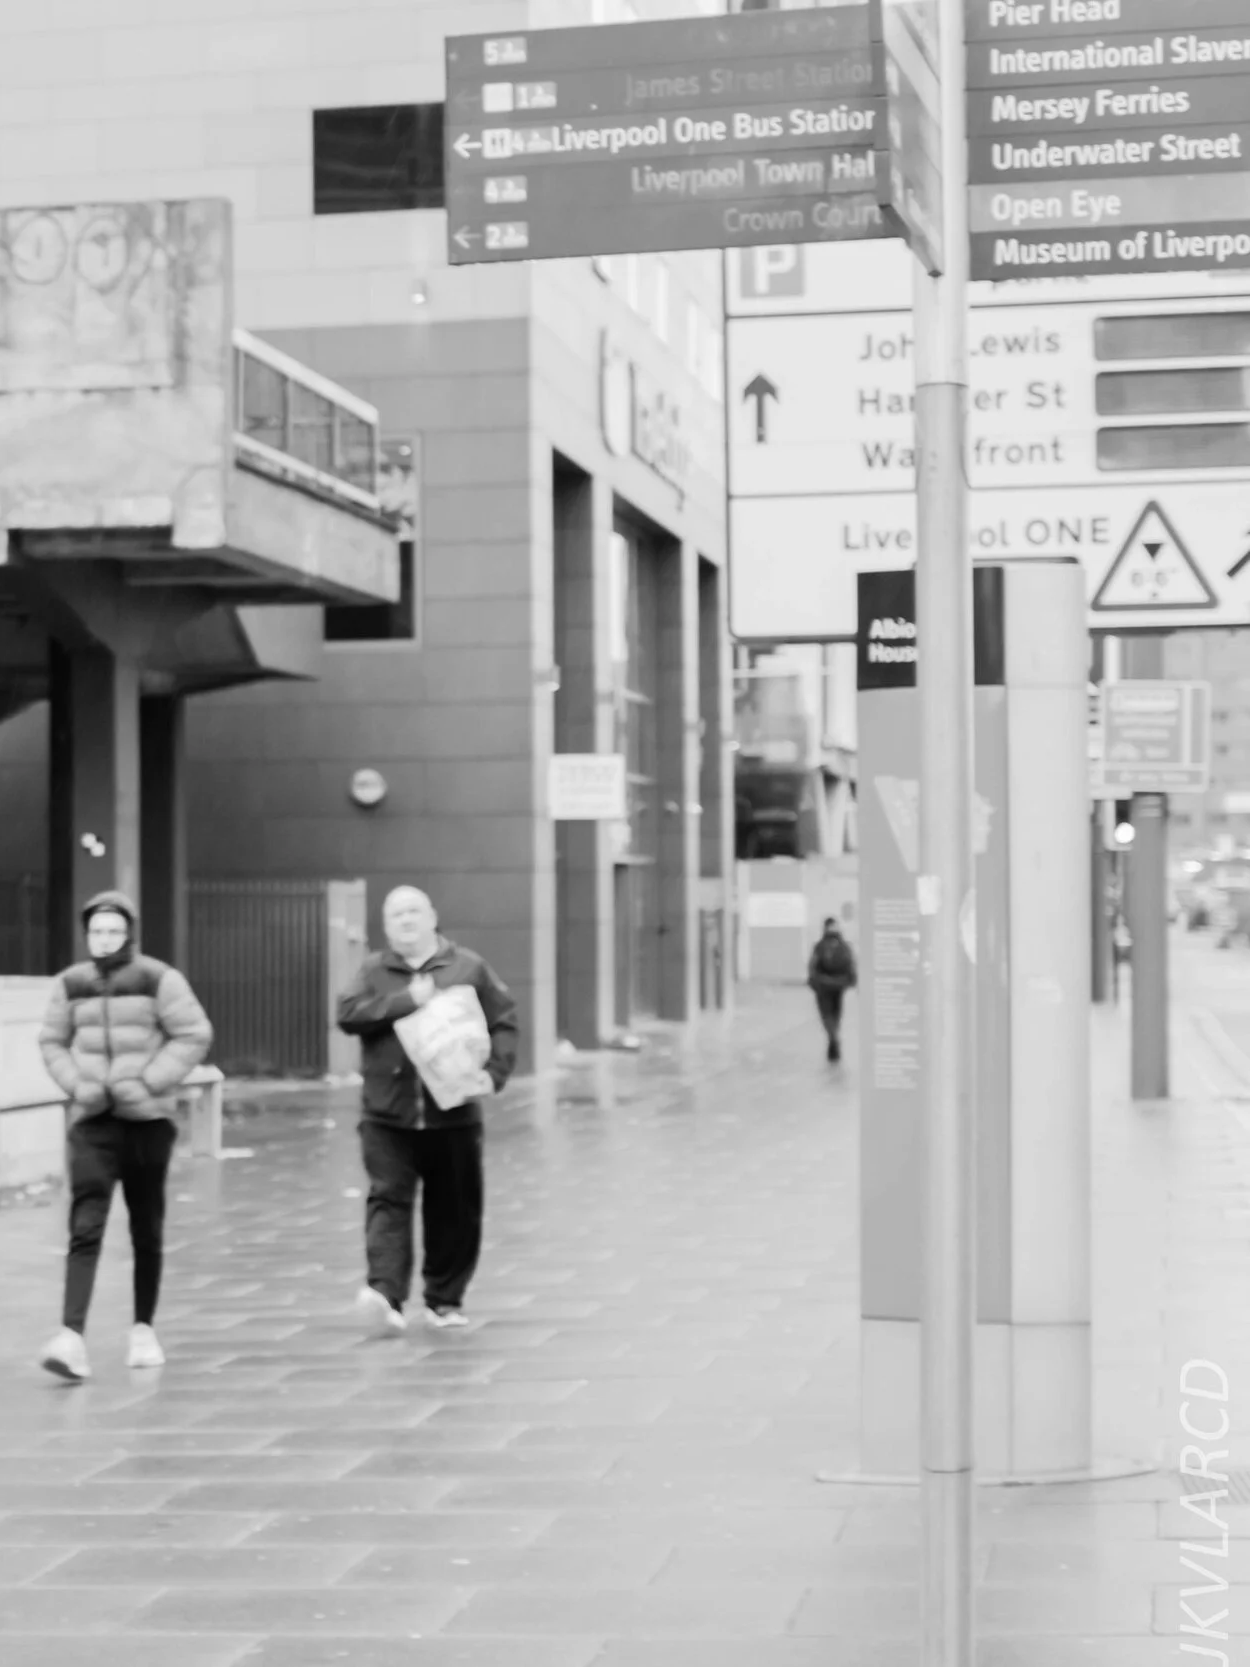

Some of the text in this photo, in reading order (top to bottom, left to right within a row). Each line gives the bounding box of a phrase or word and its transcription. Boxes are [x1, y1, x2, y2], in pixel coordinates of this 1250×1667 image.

[989, 0, 1121, 27] Pier Head
[990, 36, 1164, 75] International
[624, 73, 700, 107] James
[991, 85, 1191, 125] Mersey Ferries
[551, 117, 667, 154] Liverpool
[674, 116, 727, 143] One
[733, 111, 784, 140] Bus
[991, 132, 1242, 171] Underwater Street
[631, 158, 746, 195] Liverpool
[753, 157, 825, 188] Town
[831, 149, 876, 179] Hal
[723, 206, 805, 233] Crown
[991, 188, 1122, 226] Open Eye
[994, 238, 1111, 266] Museum
[1118, 230, 1150, 260] of
[858, 325, 1063, 362] Joh ewis
[1026, 380, 1066, 410] St
[1024, 516, 1111, 547] ONE
[868, 616, 917, 640] Albio
[867, 641, 919, 663] Hous
